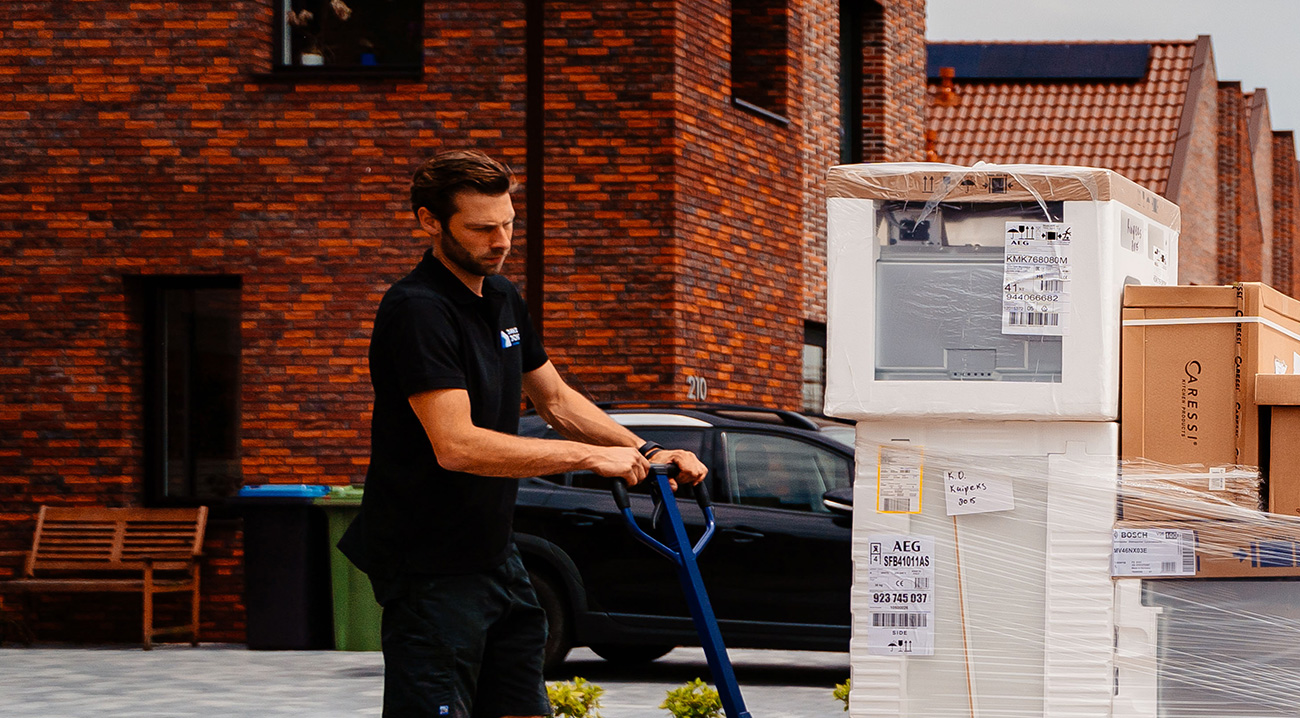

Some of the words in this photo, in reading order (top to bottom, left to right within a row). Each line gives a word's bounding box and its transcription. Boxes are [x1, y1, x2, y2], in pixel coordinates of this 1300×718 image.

[1004, 283, 1017, 292] 41
[1006, 293, 1059, 302] 944066682
[686, 375, 707, 401] 210
[1184, 360, 1202, 440] CARESSI
[1121, 531, 1148, 539] BOSCH
[893, 540, 921, 552] AEG
[883, 555, 930, 567] SFB41011AS
[873, 593, 891, 603] 923
[892, 593, 909, 603] 745
[910, 593, 927, 603] 037
